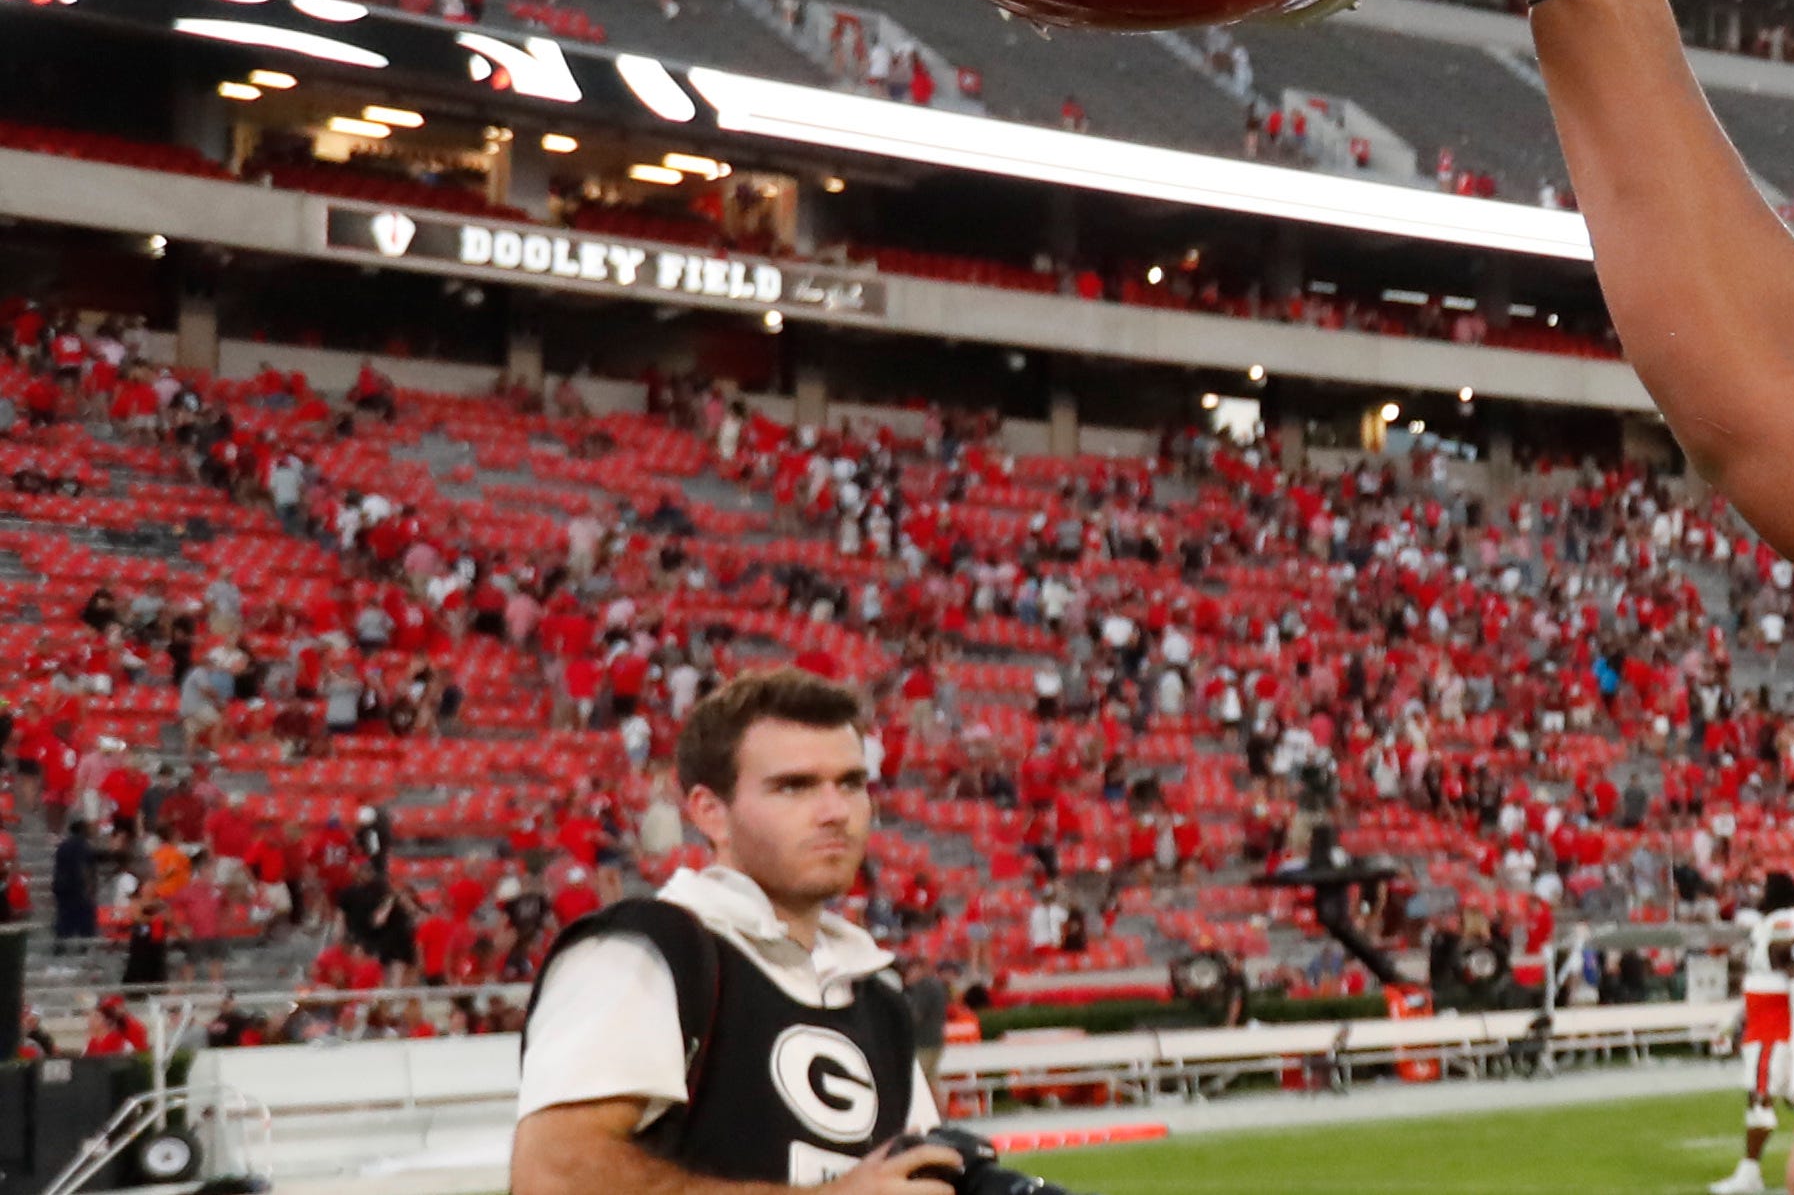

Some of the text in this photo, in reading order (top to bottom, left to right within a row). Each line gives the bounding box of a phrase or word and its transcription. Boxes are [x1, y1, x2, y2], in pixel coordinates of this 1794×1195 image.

[460, 225, 645, 285] DOOLEY
[655, 252, 782, 302] FIELD
[770, 1024, 879, 1144] G
